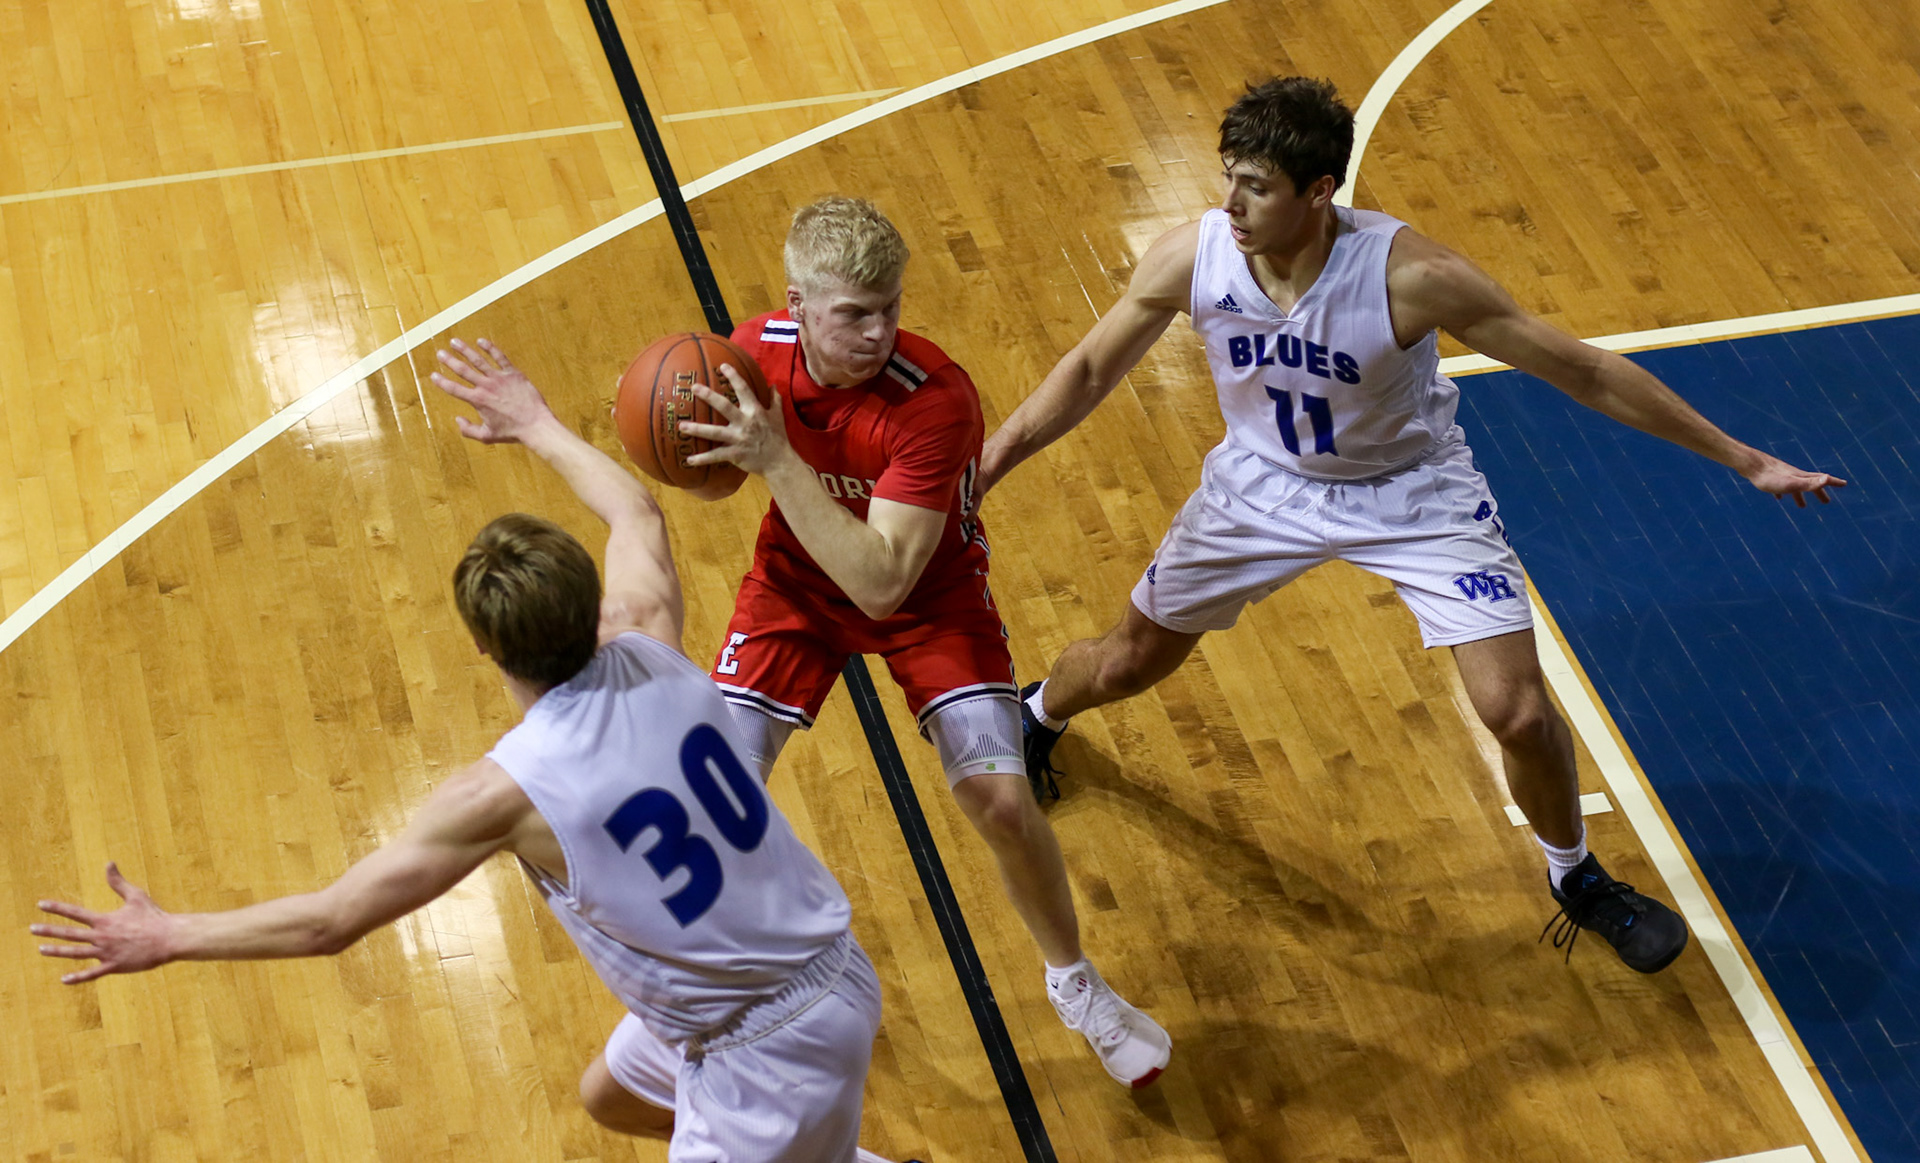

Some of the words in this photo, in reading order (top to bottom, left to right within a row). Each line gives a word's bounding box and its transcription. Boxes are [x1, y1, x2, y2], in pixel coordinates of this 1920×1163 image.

[1215, 303, 1243, 314] adidas
[1228, 333, 1362, 385] BLUES
[1264, 384, 1339, 458] 11
[1453, 569, 1517, 603] WR
[716, 631, 749, 676] E
[602, 722, 769, 930] 30
